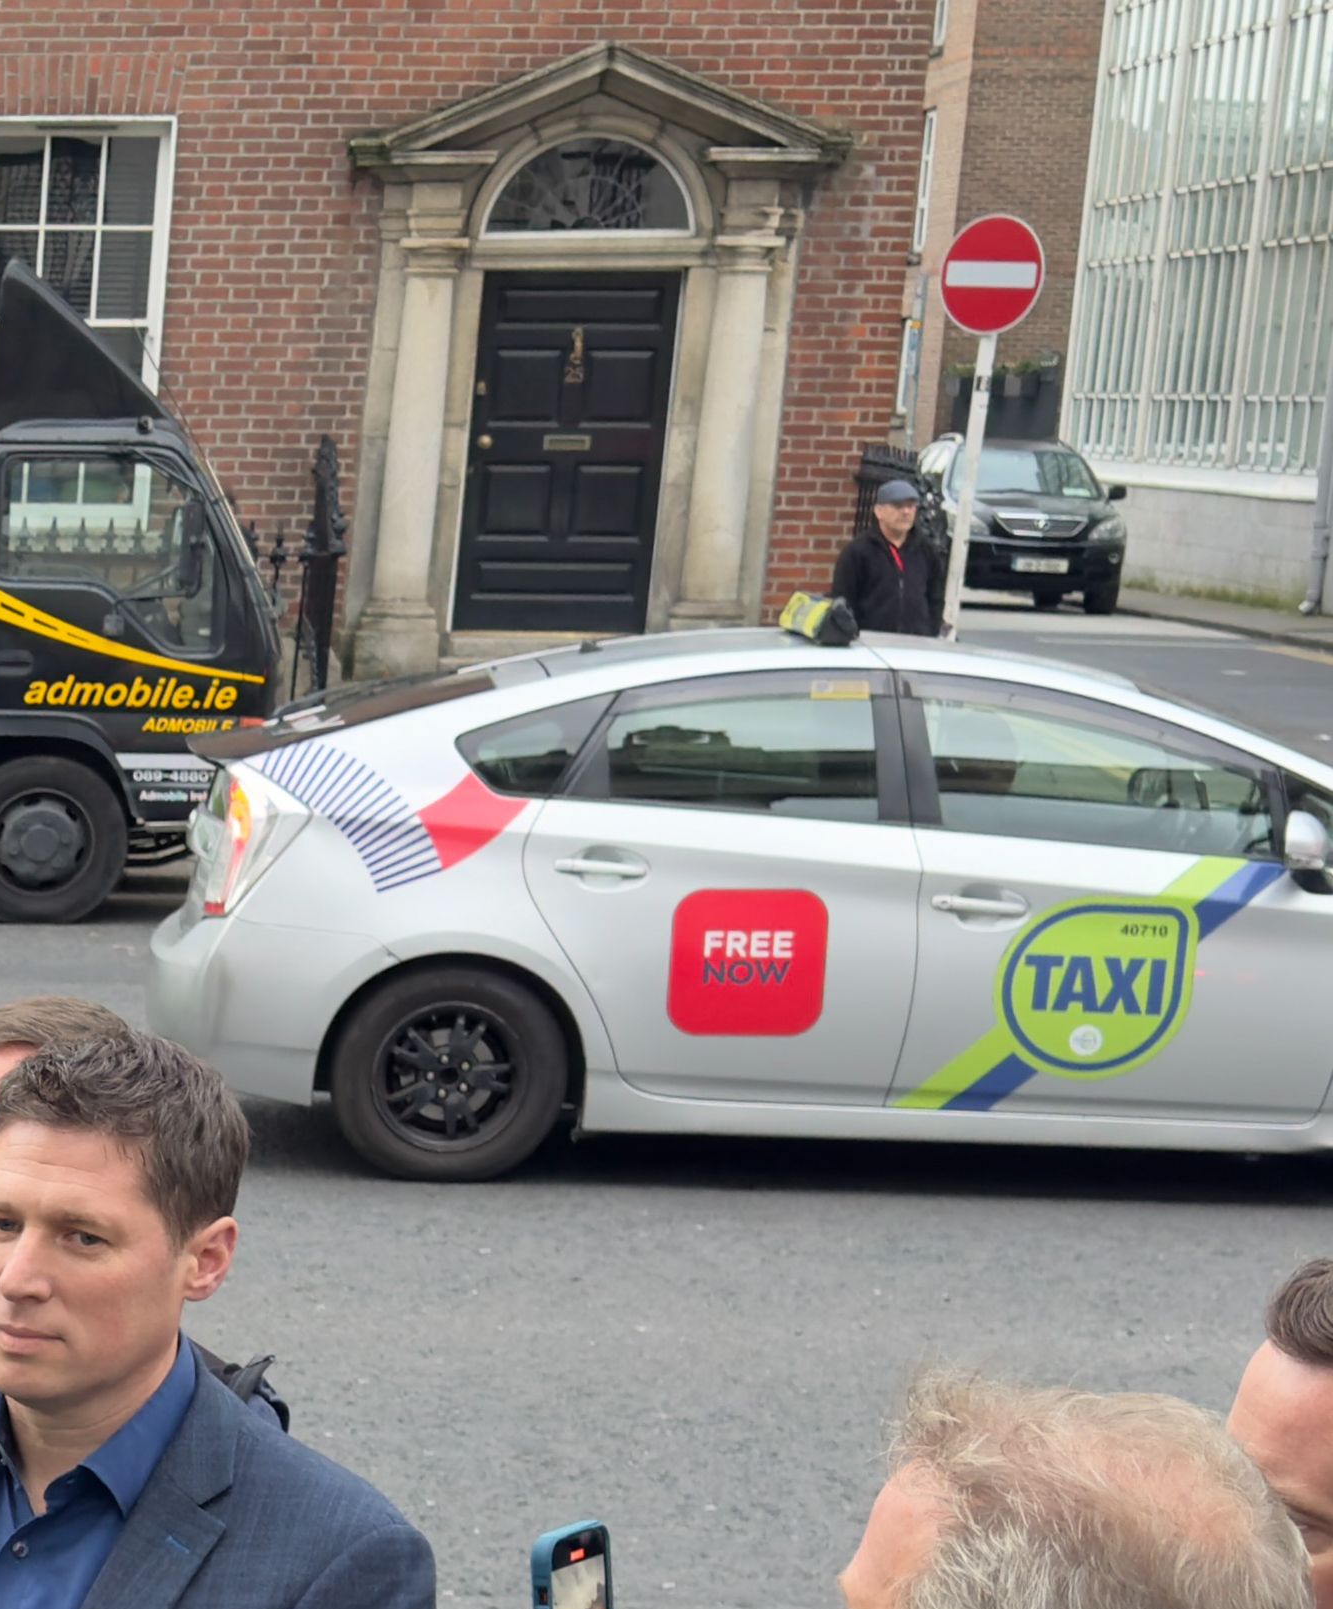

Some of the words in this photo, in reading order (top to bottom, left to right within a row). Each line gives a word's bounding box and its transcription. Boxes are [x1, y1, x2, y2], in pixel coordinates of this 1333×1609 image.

[24, 674, 237, 710] admobile.ie
[703, 930, 795, 958] FREE
[1120, 924, 1168, 938] 40710
[703, 960, 790, 984] NOW
[1025, 954, 1167, 1016] TAXI
